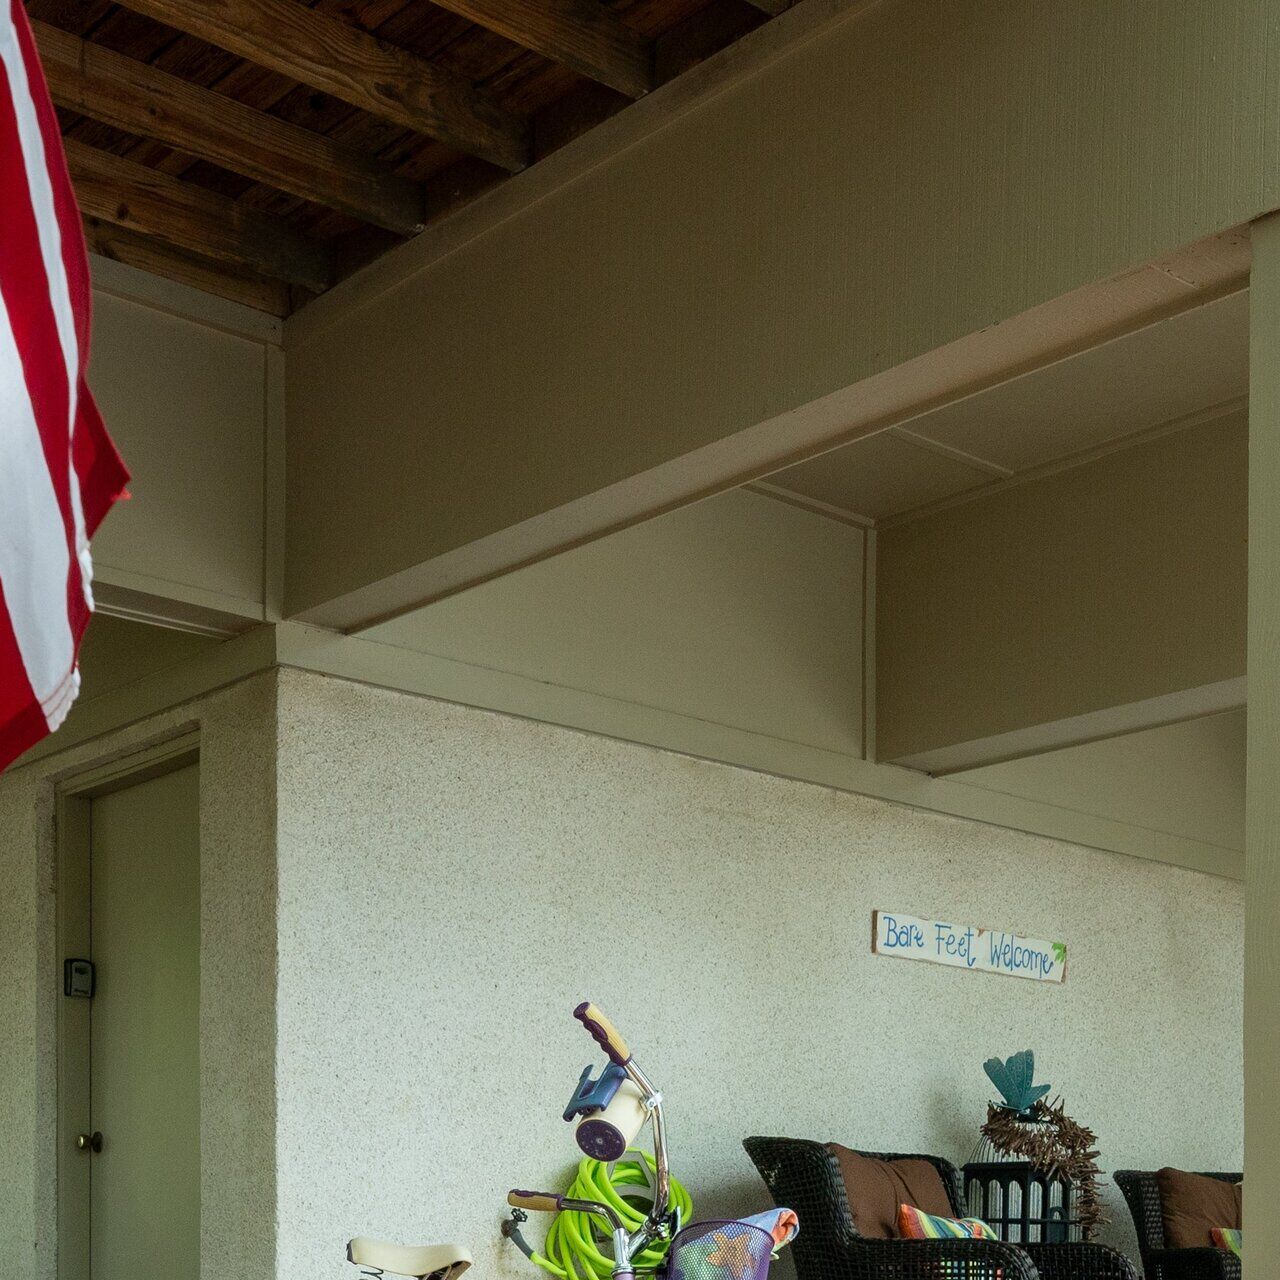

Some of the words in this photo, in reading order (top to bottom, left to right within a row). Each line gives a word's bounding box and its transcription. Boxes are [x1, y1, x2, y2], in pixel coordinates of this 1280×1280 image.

[883, 916, 925, 948] Bare
[934, 923, 976, 967] Feet
[990, 931, 1054, 979] Welcome
